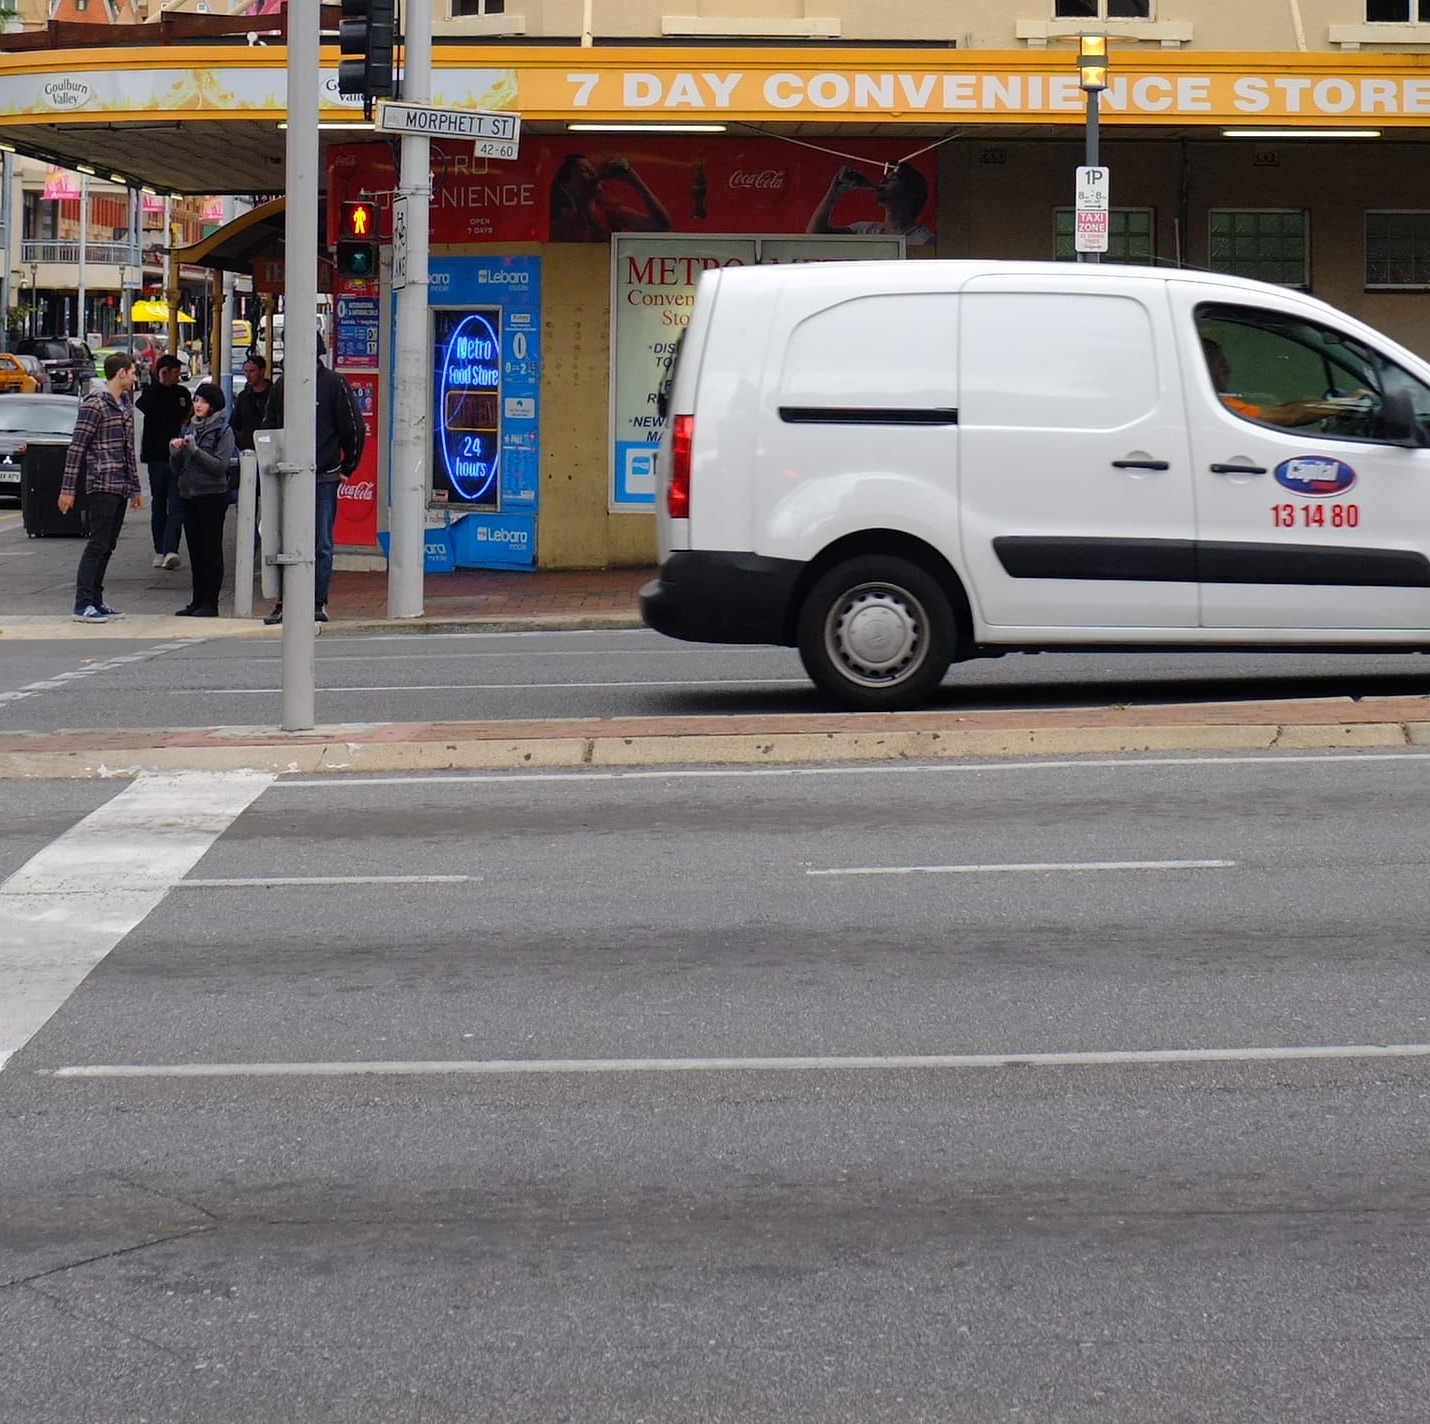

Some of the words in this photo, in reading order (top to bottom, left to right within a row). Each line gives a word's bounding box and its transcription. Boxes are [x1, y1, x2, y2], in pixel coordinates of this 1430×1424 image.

[44, 78, 88, 95] Goulburn
[566, 74, 600, 106] 7
[623, 73, 743, 107] DAY
[762, 73, 1212, 112] CONVENIENCE
[52, 92, 79, 106] Valley
[406, 111, 485, 134] MORPHETT
[491, 118, 509, 137] ST
[480, 143, 514, 158] 42-60
[1085, 169, 1103, 185] 1P
[470, 217, 490, 225] OPEN
[1080, 213, 1104, 222] TAXI
[1078, 223, 1105, 232] ZONE
[488, 270, 529, 284] Lebara
[627, 289, 695, 306] Conven
[662, 310, 690, 326] Sto
[457, 337, 491, 360] Metro
[449, 365, 471, 385] Food
[472, 364, 499, 386] Store
[463, 436, 482, 457] 24
[456, 456, 487, 477] hours
[1270, 504, 1295, 527] 13
[1301, 504, 1325, 527] 14
[1332, 504, 1358, 527] 80
[488, 527, 528, 543] Lebara
